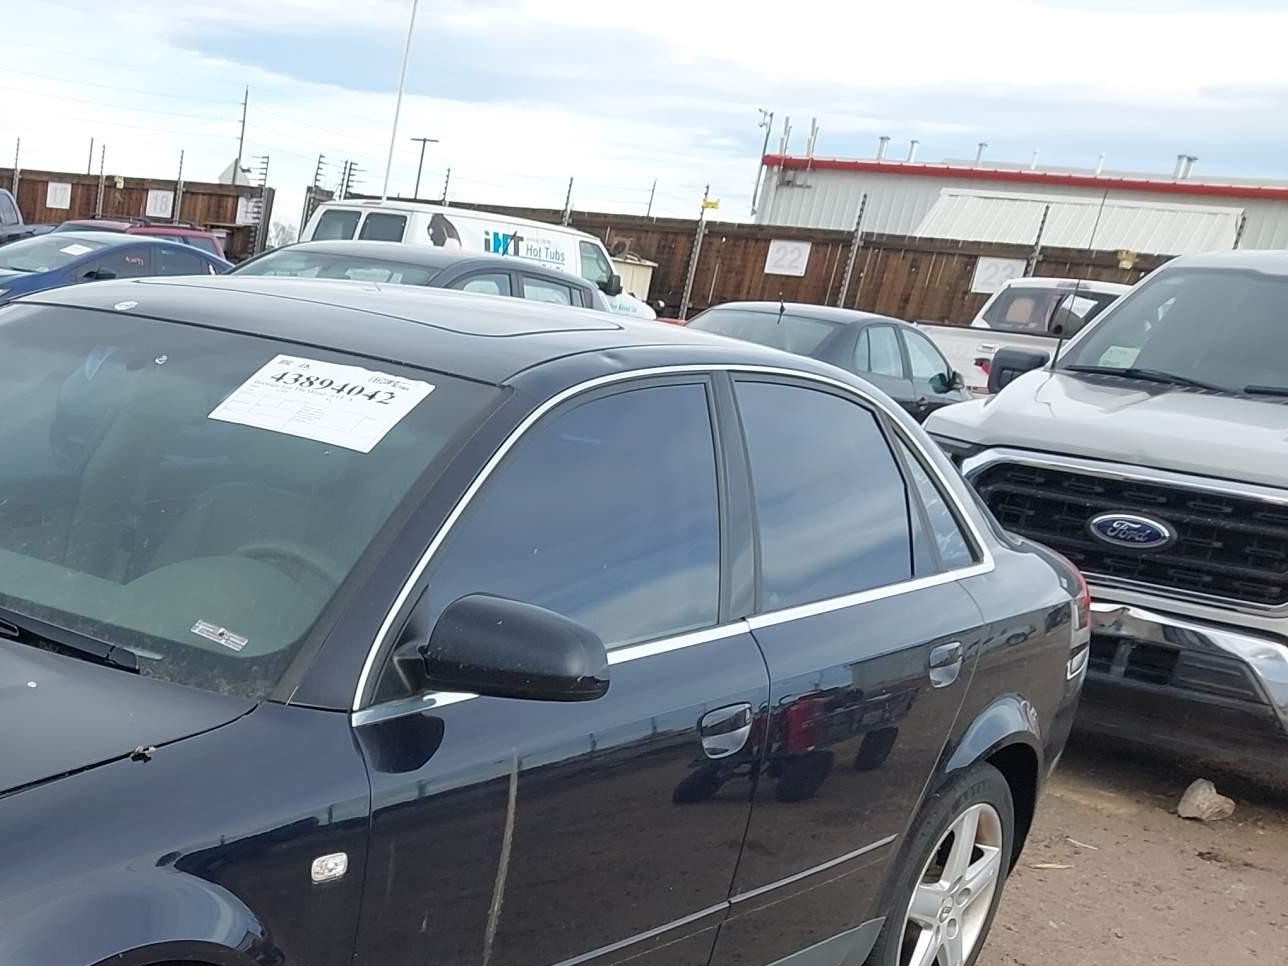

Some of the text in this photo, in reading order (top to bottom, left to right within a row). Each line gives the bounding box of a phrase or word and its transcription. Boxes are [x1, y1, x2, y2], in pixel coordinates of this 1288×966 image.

[153, 194, 170, 213] 18
[526, 244, 565, 262] Hot Tubs
[774, 245, 802, 269] 22
[270, 371, 396, 405] 43894042
[1106, 520, 1151, 542] Ford
